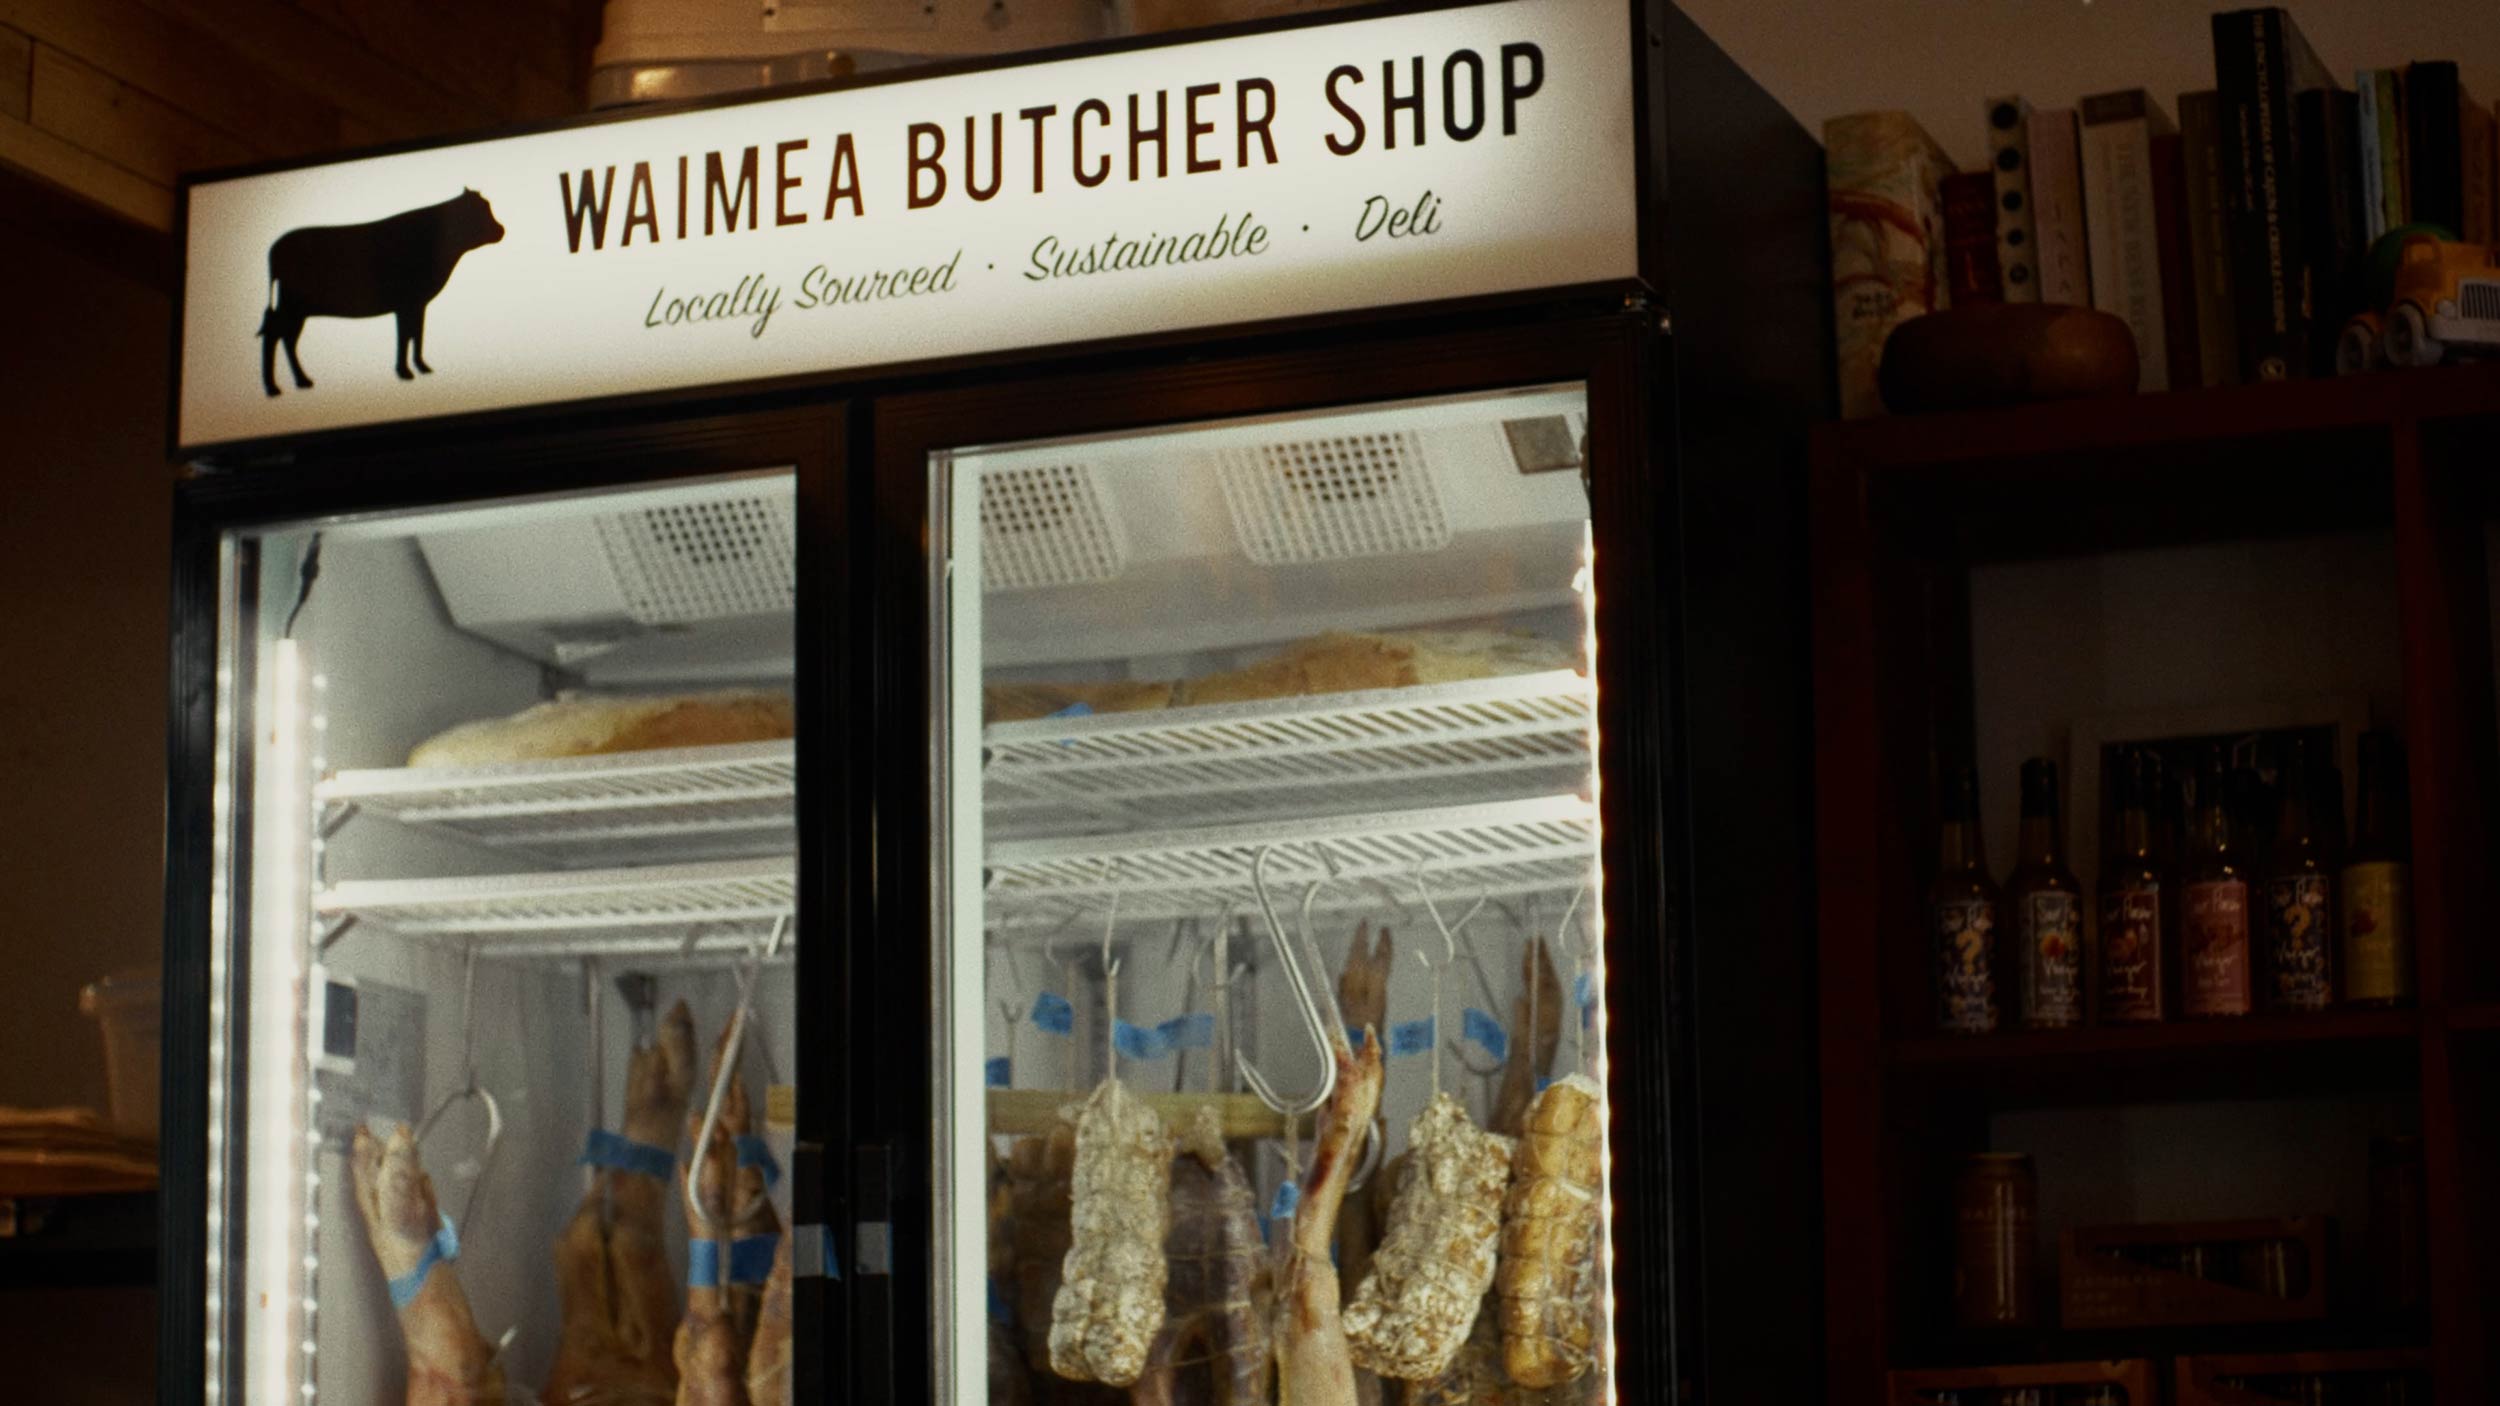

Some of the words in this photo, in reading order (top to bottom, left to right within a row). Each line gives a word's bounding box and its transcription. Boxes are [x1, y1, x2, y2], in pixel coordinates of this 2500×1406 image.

[559, 132, 864, 254] WAIMEA
[907, 76, 1279, 210] BUTCHER
[1324, 40, 1547, 156] SHOP
[645, 272, 782, 339] Locally
[793, 248, 963, 310] Sourced
[1022, 211, 1270, 281] Sustainable
[1355, 190, 1443, 242] Deli
